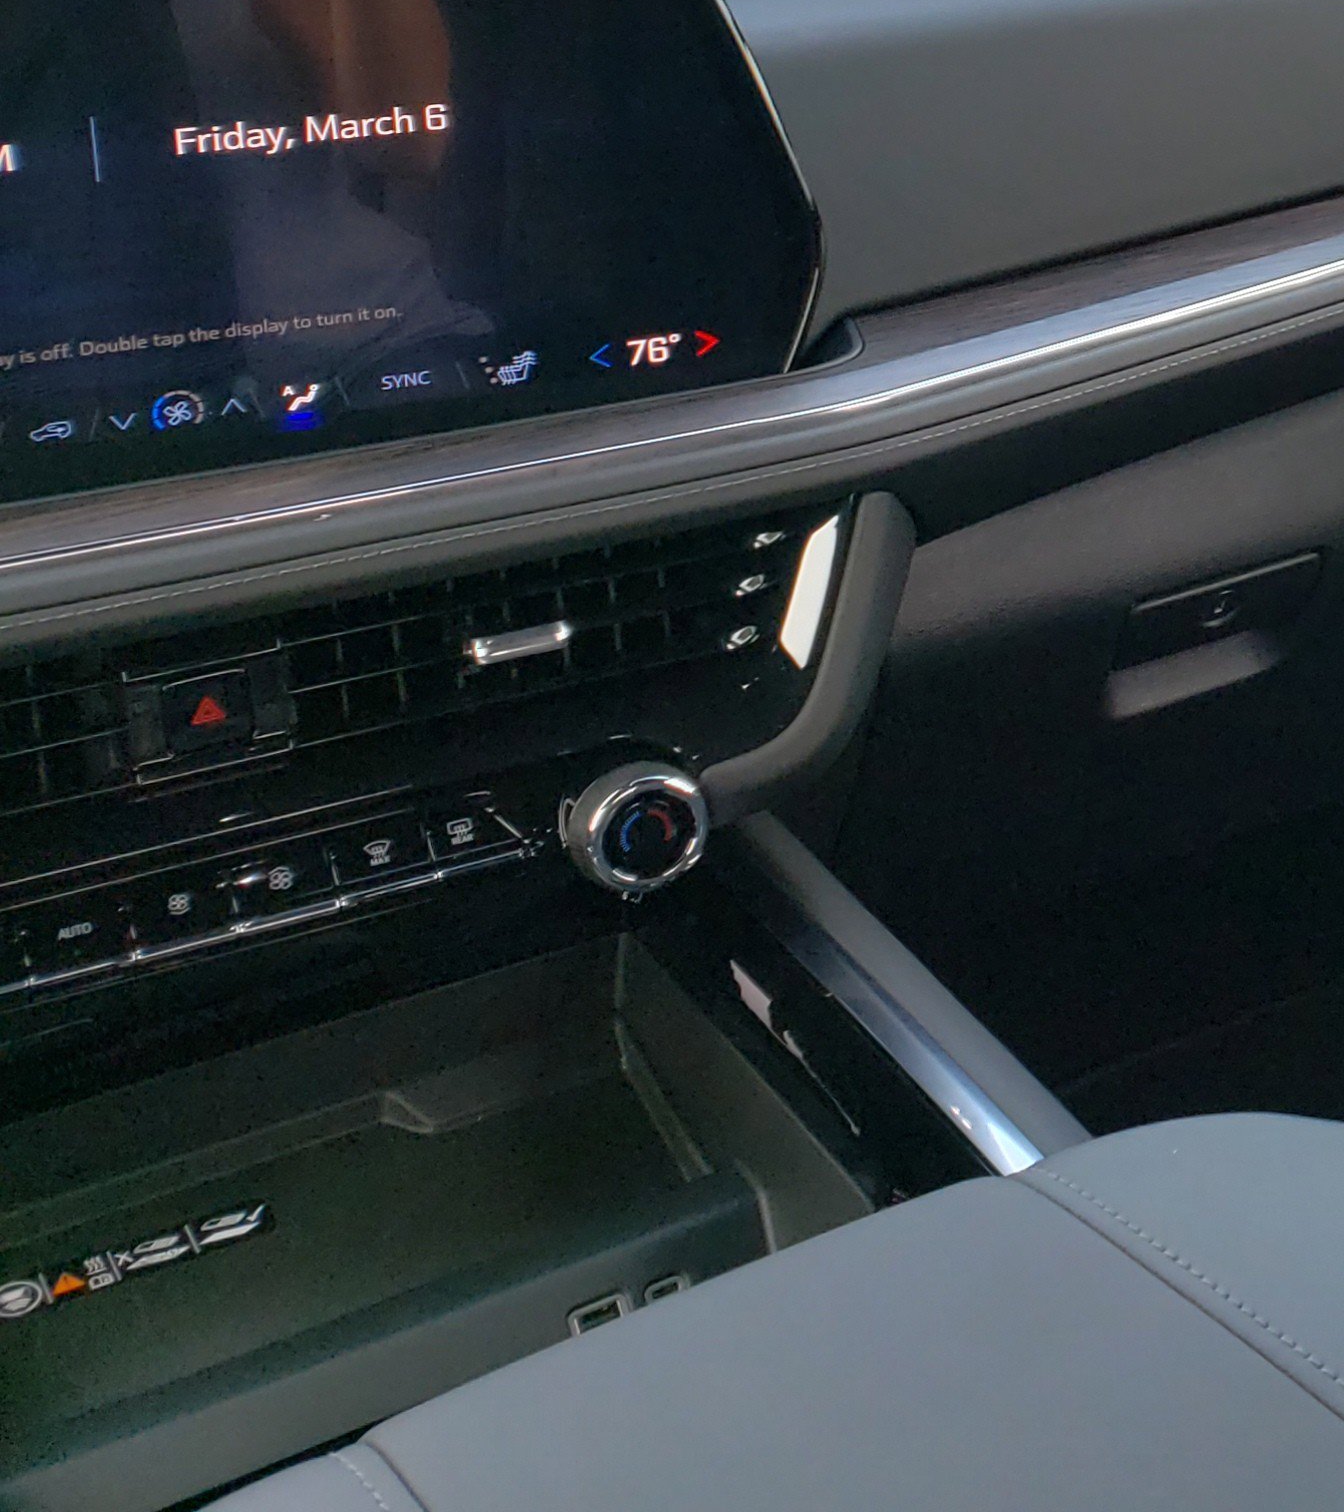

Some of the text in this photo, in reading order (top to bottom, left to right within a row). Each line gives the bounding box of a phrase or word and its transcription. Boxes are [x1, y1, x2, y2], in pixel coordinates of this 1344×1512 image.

[173, 104, 449, 156] Friday, March 6
[21, 347, 36, 365] is
[40, 343, 74, 364] off.
[79, 333, 149, 358] Double
[152, 330, 184, 352] tap
[187, 325, 220, 345] the
[223, 317, 291, 343] display
[293, 315, 312, 331] to
[316, 313, 352, 329] turn
[373, 308, 403, 323] on.
[627, 333, 682, 368] 76°
[380, 370, 431, 390] SYNC
[57, 921, 93, 941] AUTO
